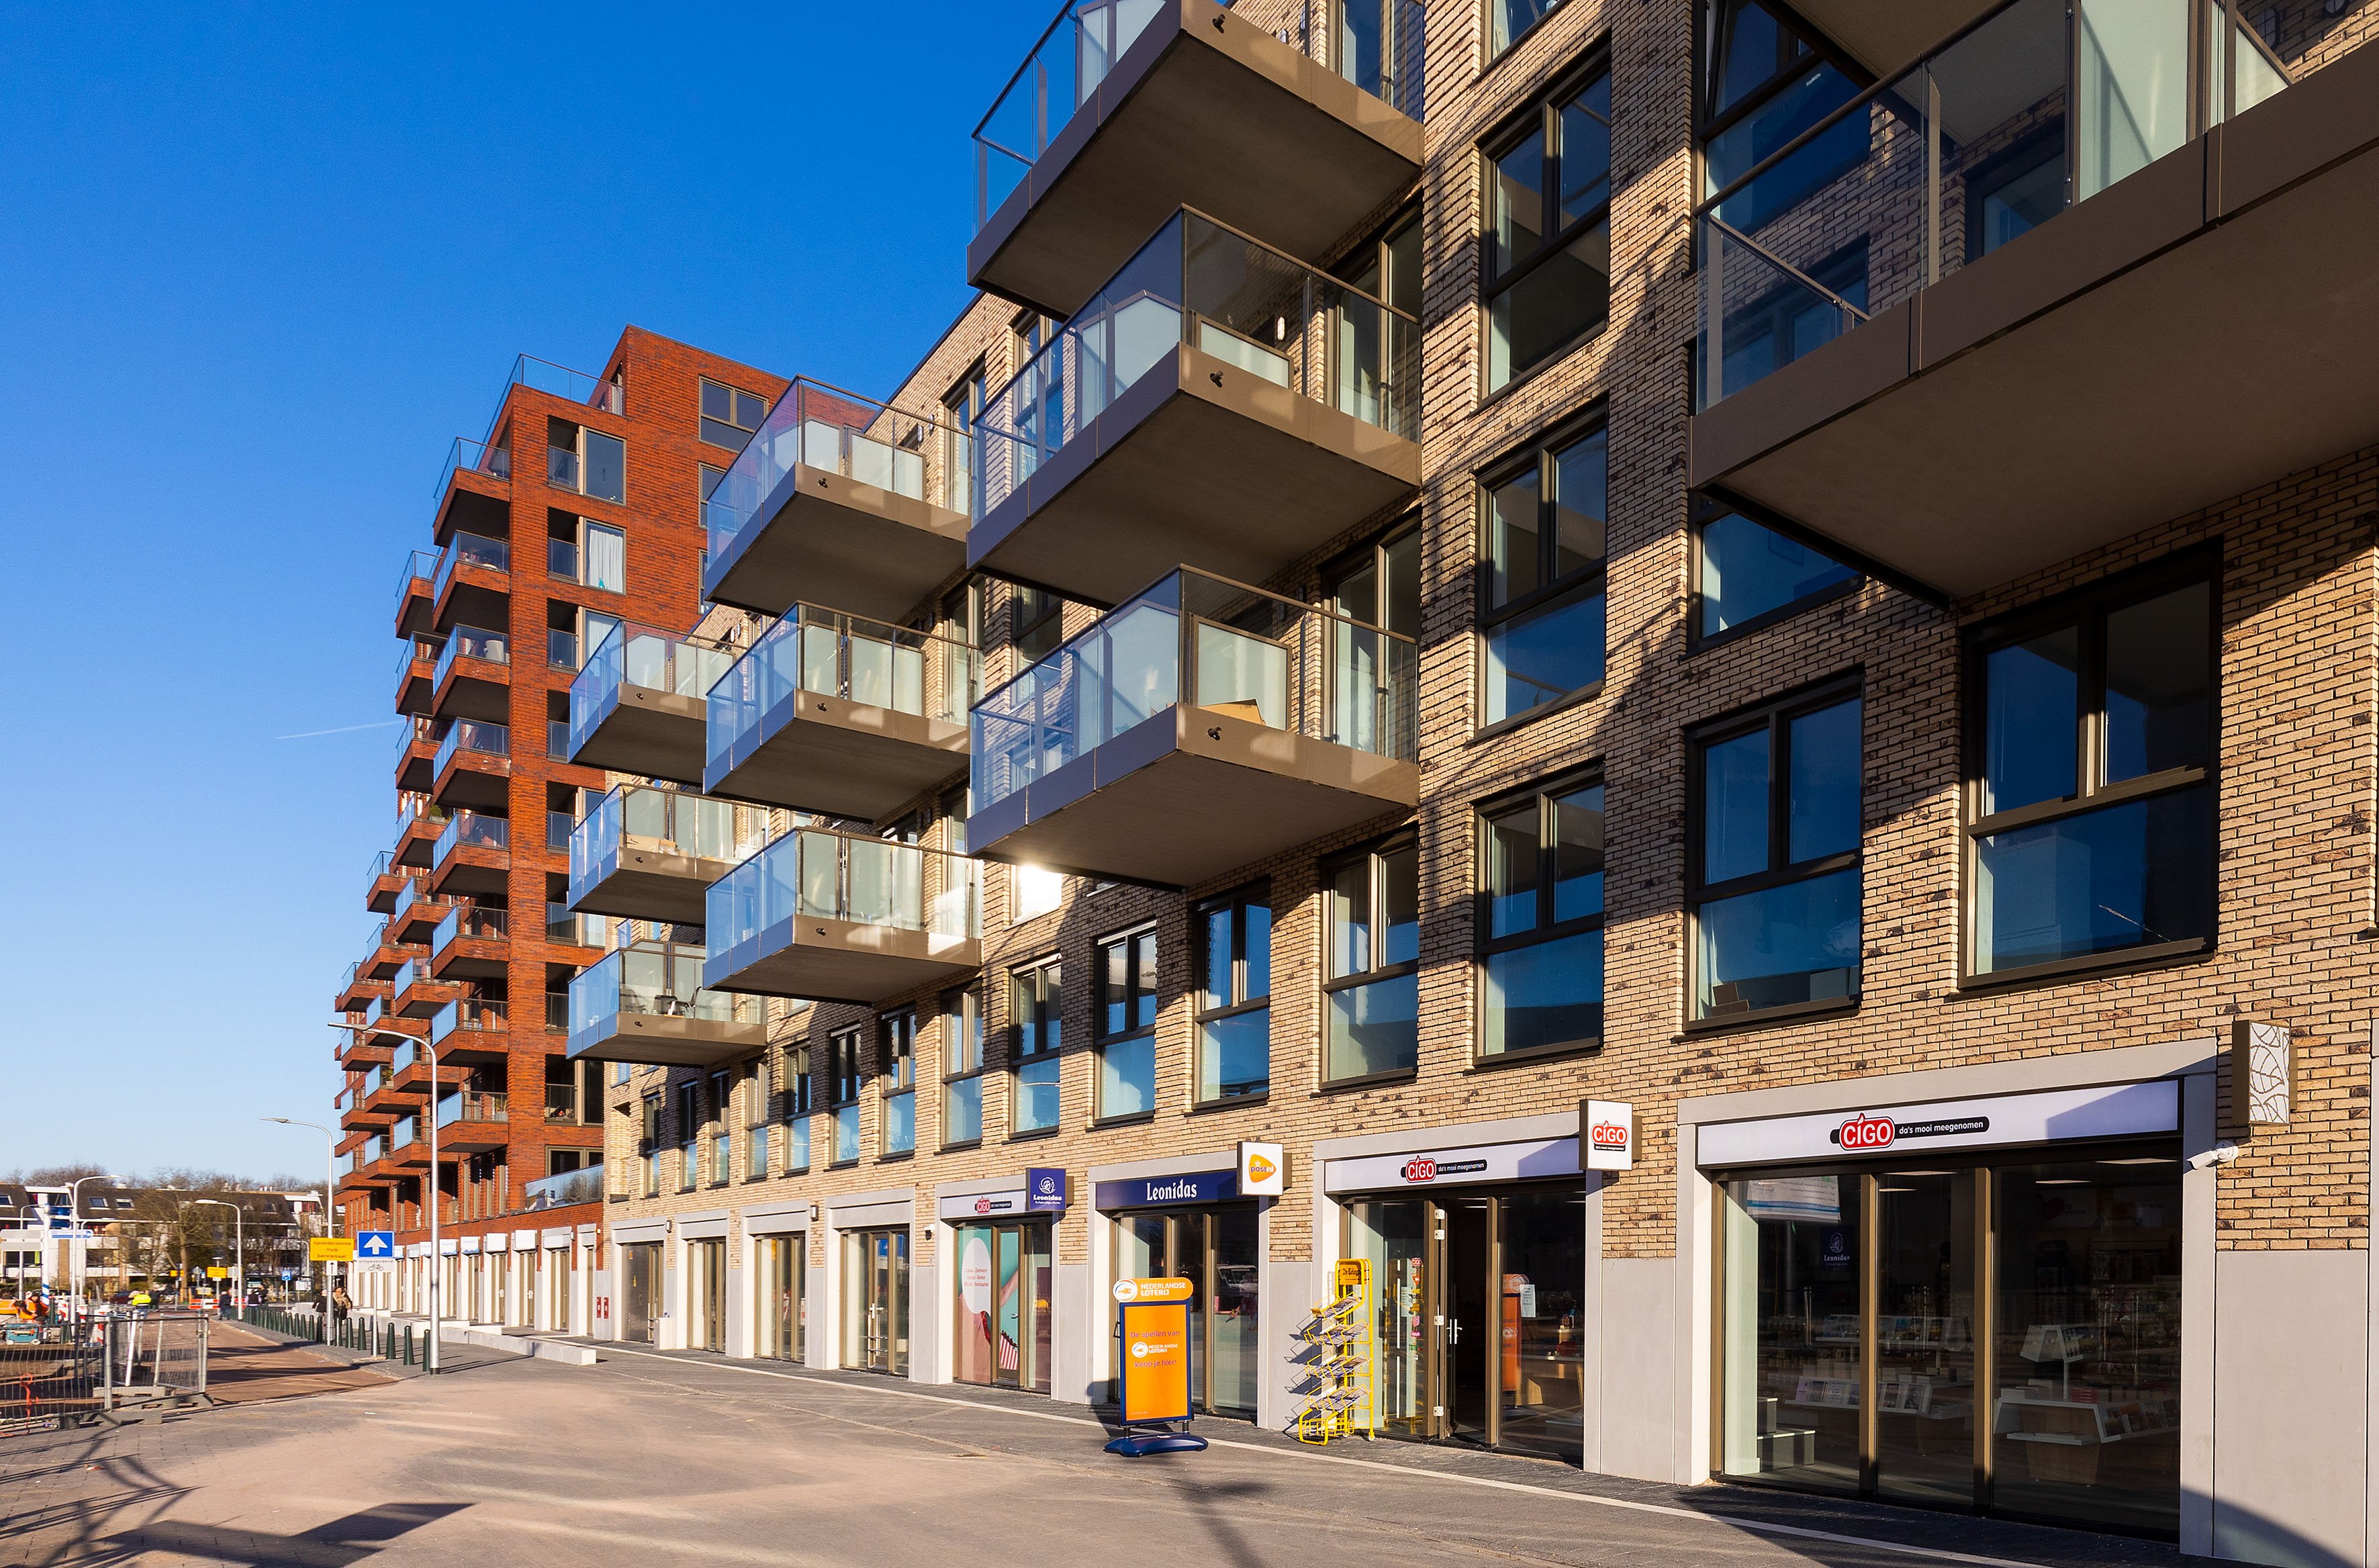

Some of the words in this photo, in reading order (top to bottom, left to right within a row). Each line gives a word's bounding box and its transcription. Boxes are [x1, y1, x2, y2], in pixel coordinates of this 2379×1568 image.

[1593, 1123, 1626, 1143] CIGO
[1844, 1117, 1892, 1145] CIGO
[1899, 1126, 1914, 1135] da's
[1915, 1124, 1932, 1134] mooi
[1934, 1121, 1984, 1132] meegenomen
[1408, 1158, 1434, 1179] CIGO
[1146, 1178, 1197, 1201] Leonidas
[978, 1198, 990, 1212] CIGO
[1141, 1330, 1166, 1338] spellen
[1154, 1360, 1160, 1368] je
[1161, 1358, 1177, 1367] hier!
